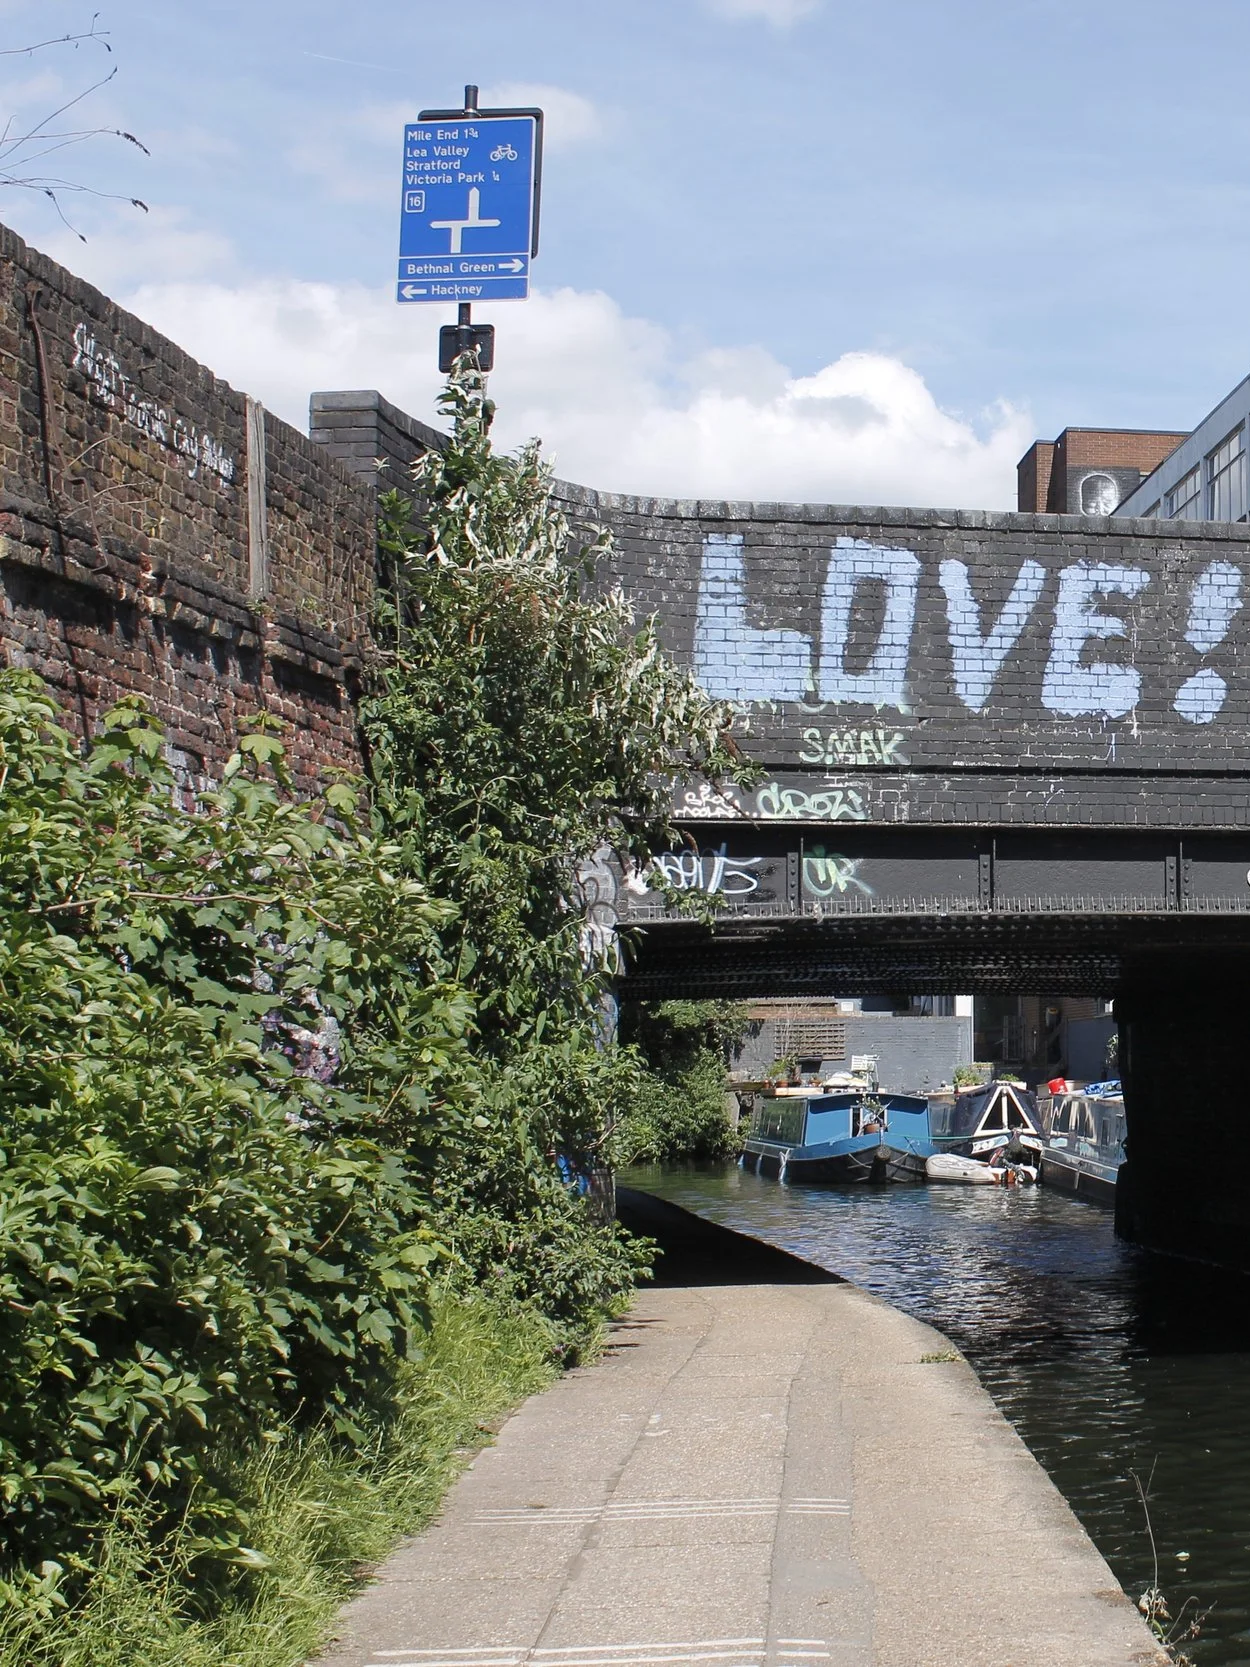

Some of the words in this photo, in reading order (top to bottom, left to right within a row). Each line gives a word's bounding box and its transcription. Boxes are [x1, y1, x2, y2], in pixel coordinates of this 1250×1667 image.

[407, 130, 432, 141] Mile
[437, 129, 459, 140] End
[407, 147, 428, 157] Lea
[433, 145, 469, 157] Valley
[406, 159, 460, 171] Stratford
[406, 174, 452, 185] Victoria
[458, 172, 485, 183] Park
[409, 196, 421, 207] 16
[407, 263, 454, 274] Bethnal
[460, 262, 495, 273] Green
[431, 284, 483, 296] Hackney
[694, 533, 1244, 724] LOVE!
